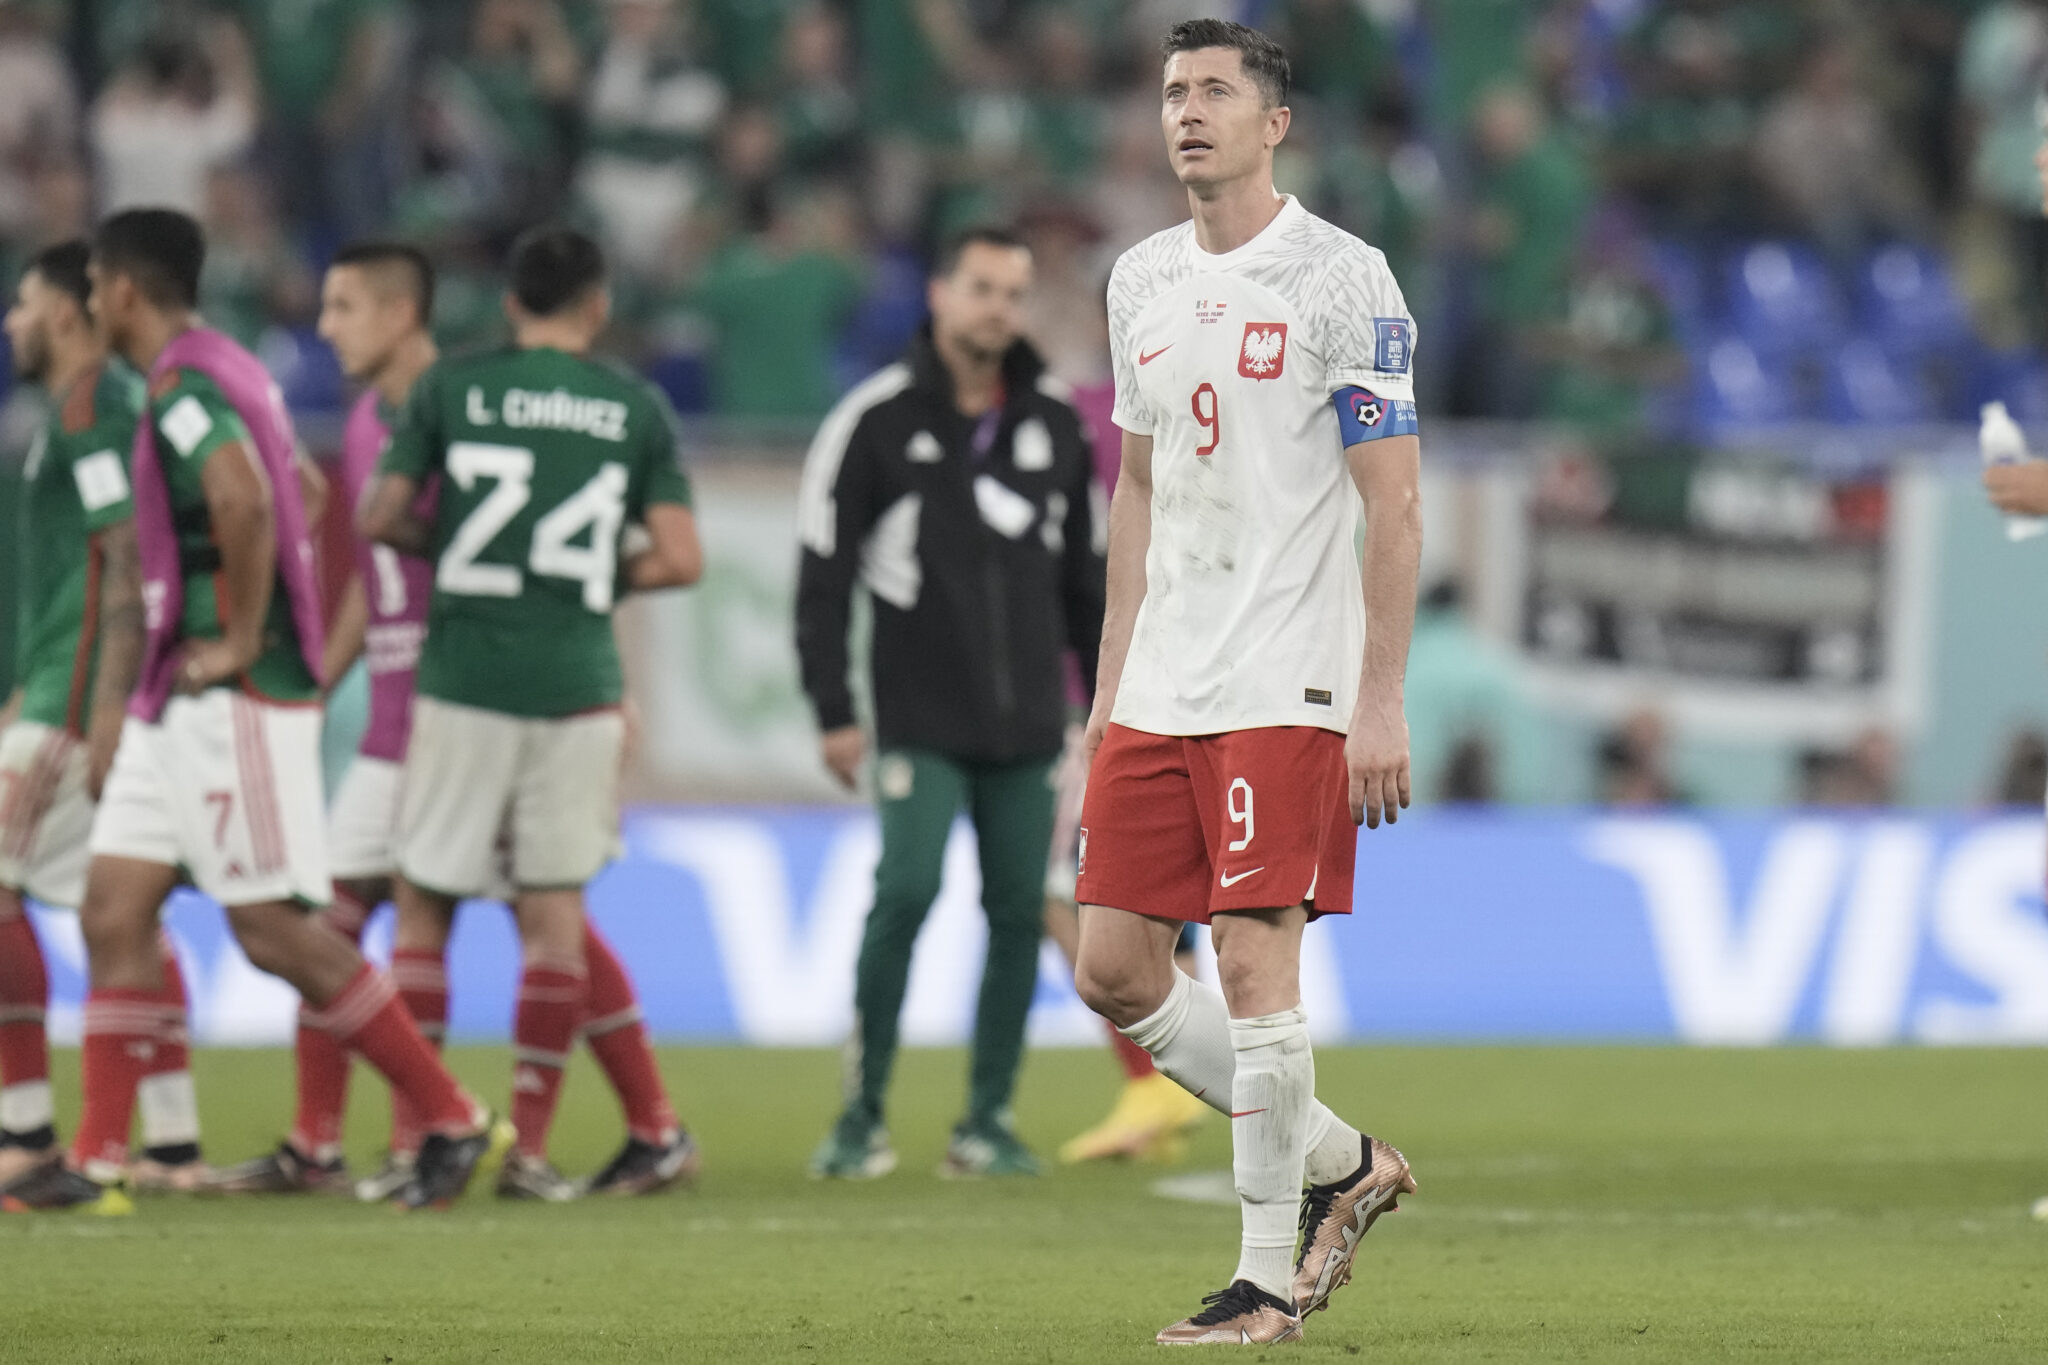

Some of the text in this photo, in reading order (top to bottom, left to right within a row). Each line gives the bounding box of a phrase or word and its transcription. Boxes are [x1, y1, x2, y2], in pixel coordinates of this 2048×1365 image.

[1191, 382, 1220, 456] 9
[436, 441, 630, 614] 24
[203, 792, 233, 848] 7
[1227, 777, 1255, 851] 9
[1588, 815, 2048, 1046] VIS
